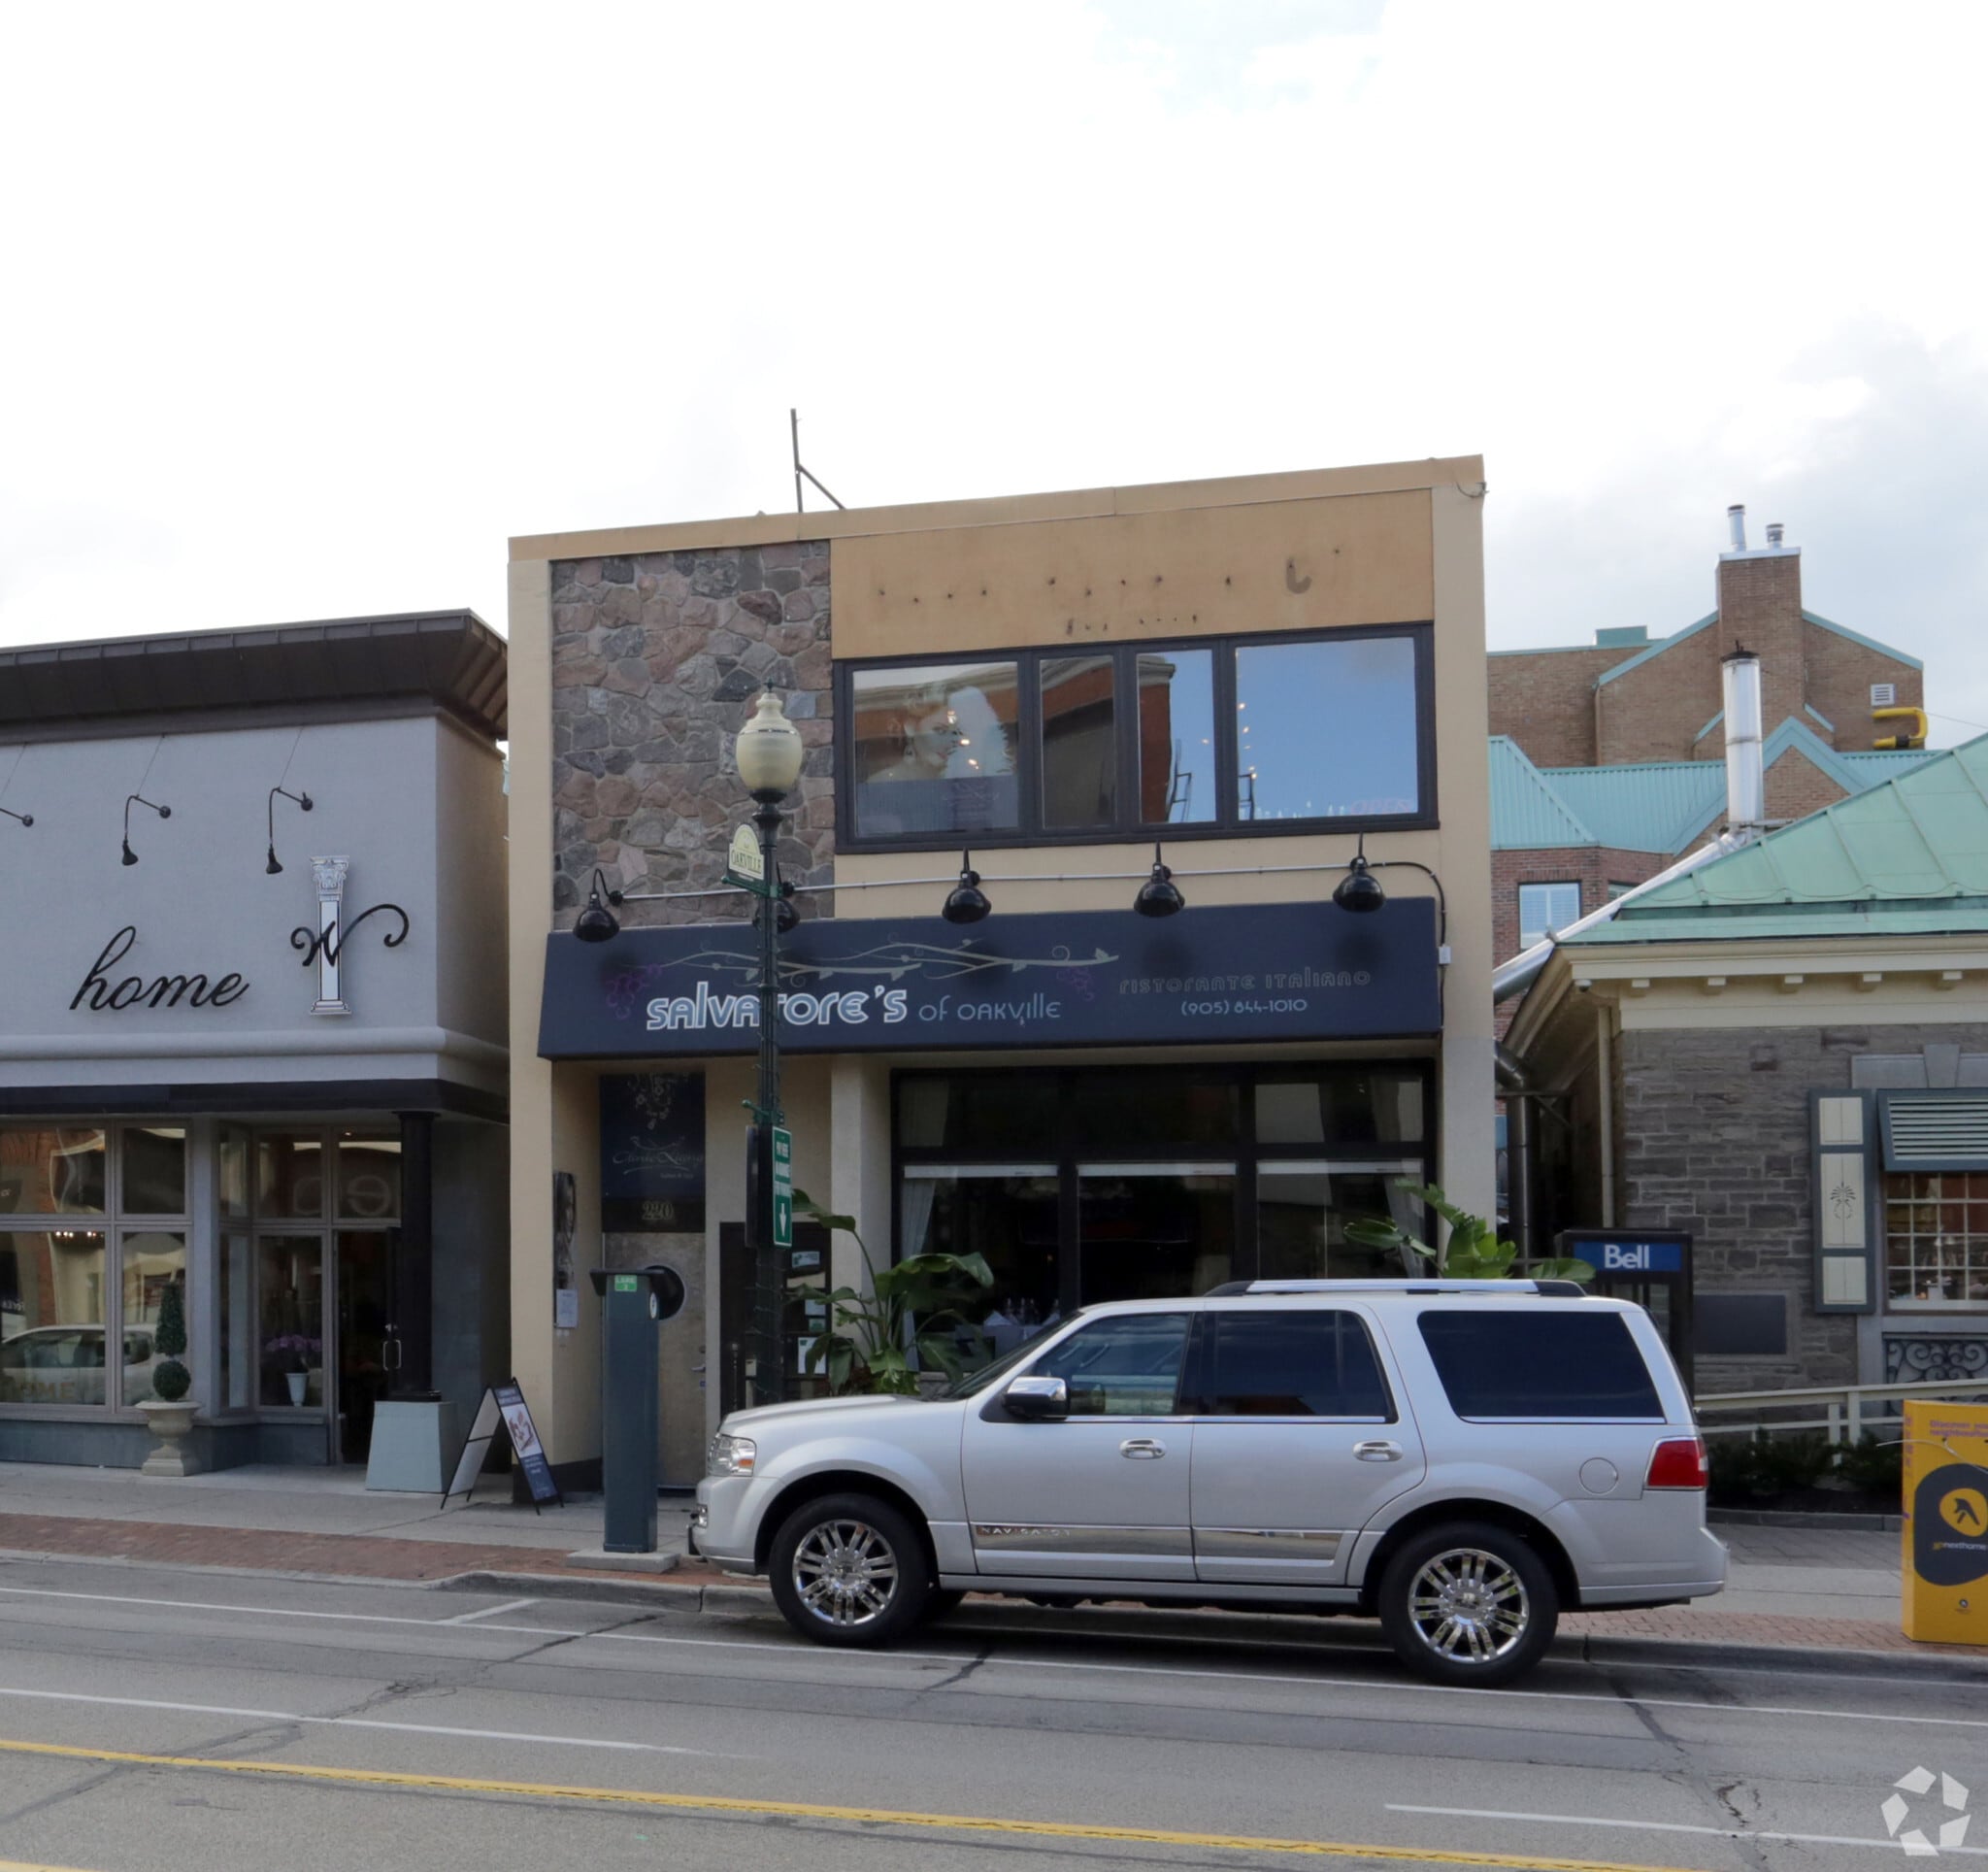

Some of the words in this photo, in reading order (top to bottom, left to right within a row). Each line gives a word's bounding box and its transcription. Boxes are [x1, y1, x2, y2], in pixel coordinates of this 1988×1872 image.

[69, 926, 249, 1011] home
[646, 981, 908, 1030] salvaore's
[918, 994, 951, 1021] of
[1180, 999, 1230, 1016] (905)
[1234, 998, 1308, 1014] 844-1010
[1605, 1244, 1650, 1269] Bell
